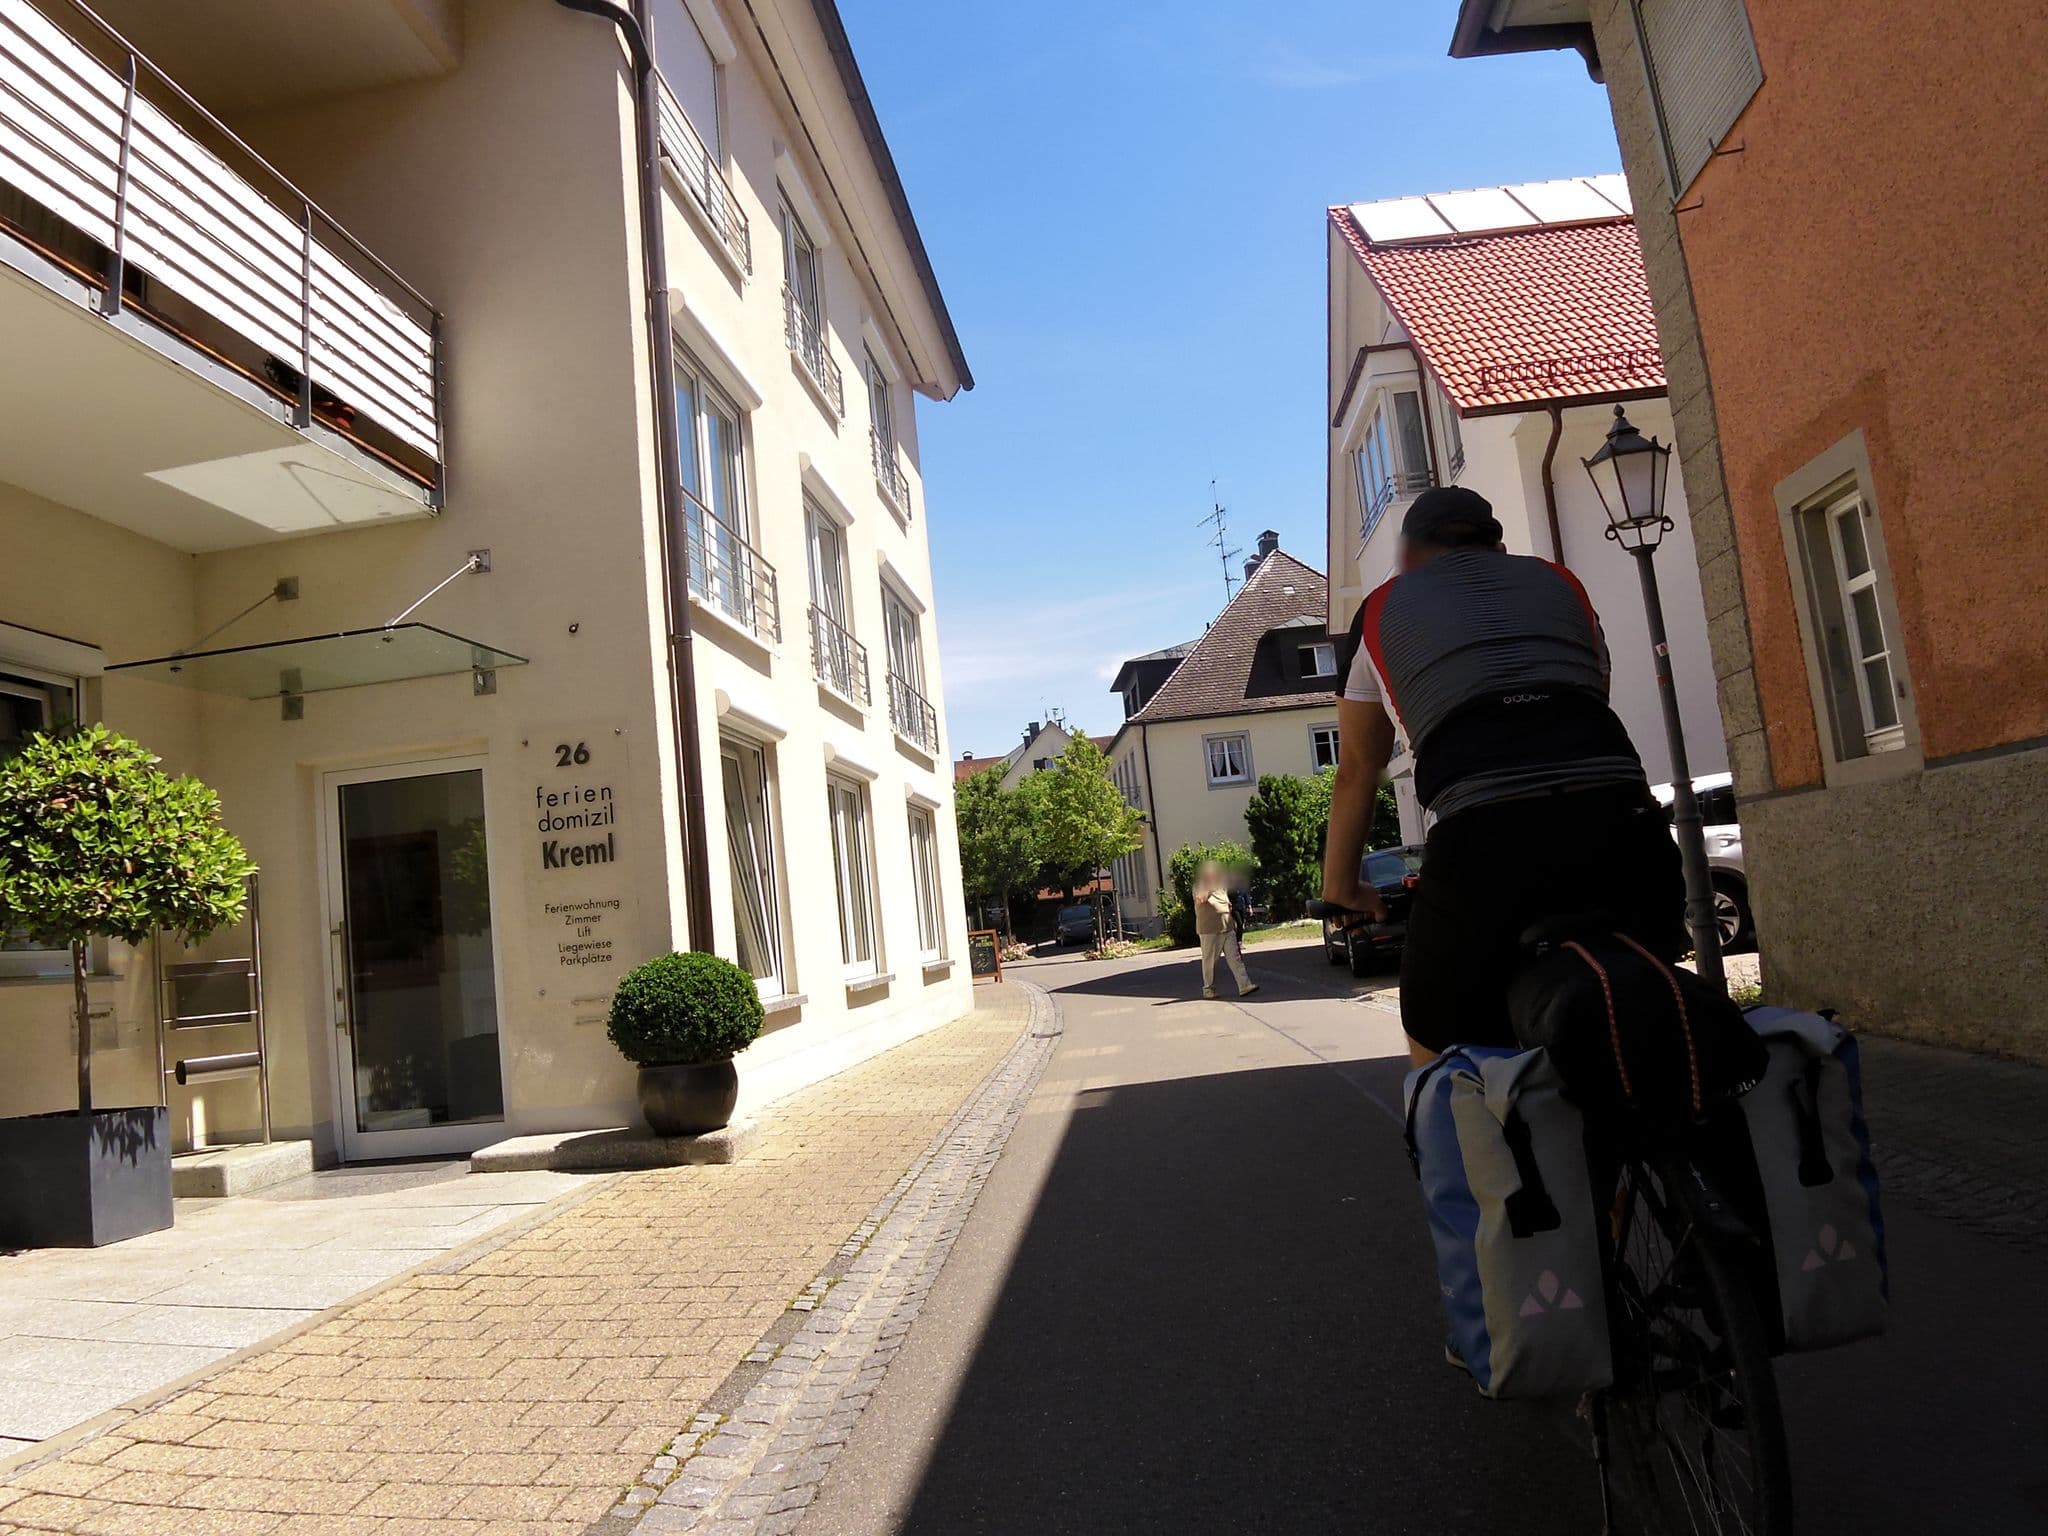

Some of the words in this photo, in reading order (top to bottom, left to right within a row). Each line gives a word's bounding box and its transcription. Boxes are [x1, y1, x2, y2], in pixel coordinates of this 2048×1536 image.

[555, 742, 590, 767] 26
[536, 785, 612, 808] ferien
[538, 802, 614, 832] domizil
[542, 833, 614, 869] Kreml
[544, 899, 620, 914] Ferienwohnung
[565, 915, 601, 926] Zimmer
[577, 926, 591, 937] Lift
[558, 941, 612, 954] Liegewiese
[560, 953, 612, 967] Parkplätze
